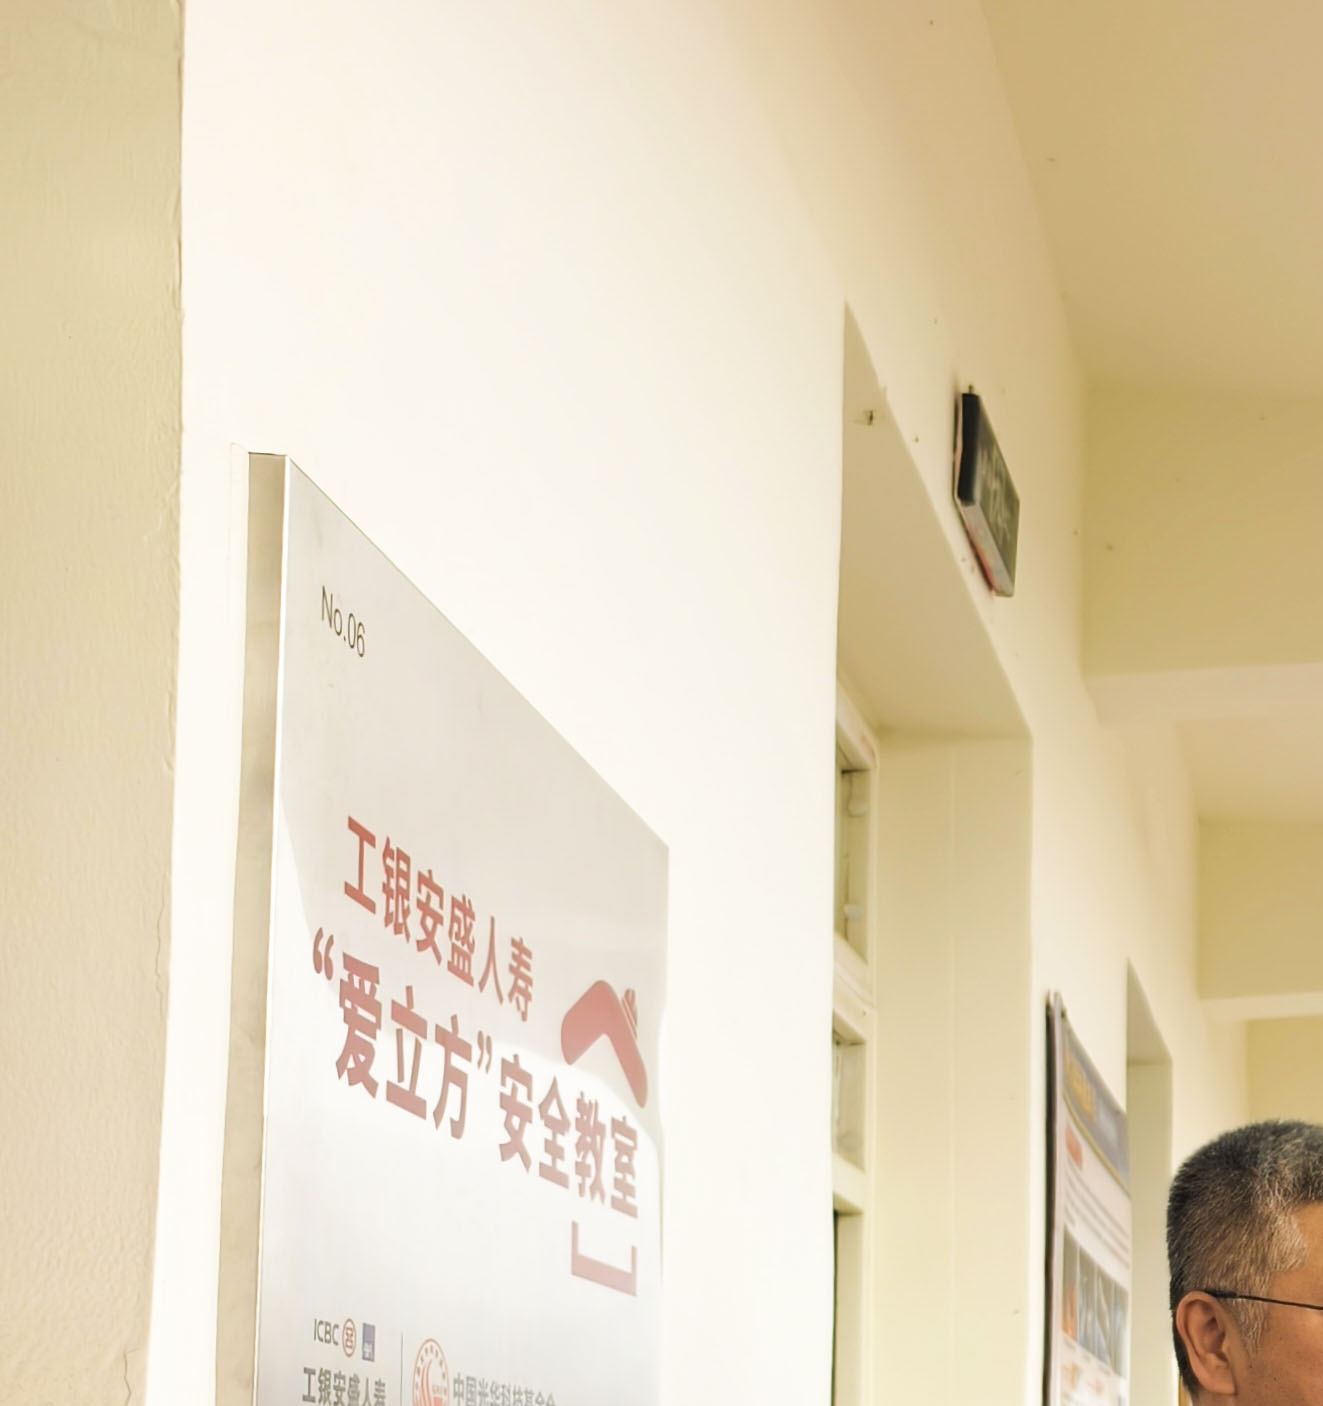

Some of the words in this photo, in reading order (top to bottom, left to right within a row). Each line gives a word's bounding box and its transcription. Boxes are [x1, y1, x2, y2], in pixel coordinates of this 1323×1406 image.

[321, 584, 366, 658] No.06
[343, 815, 534, 1023] 工银安盛人寿
[313, 1318, 339, 1346] ICBC
